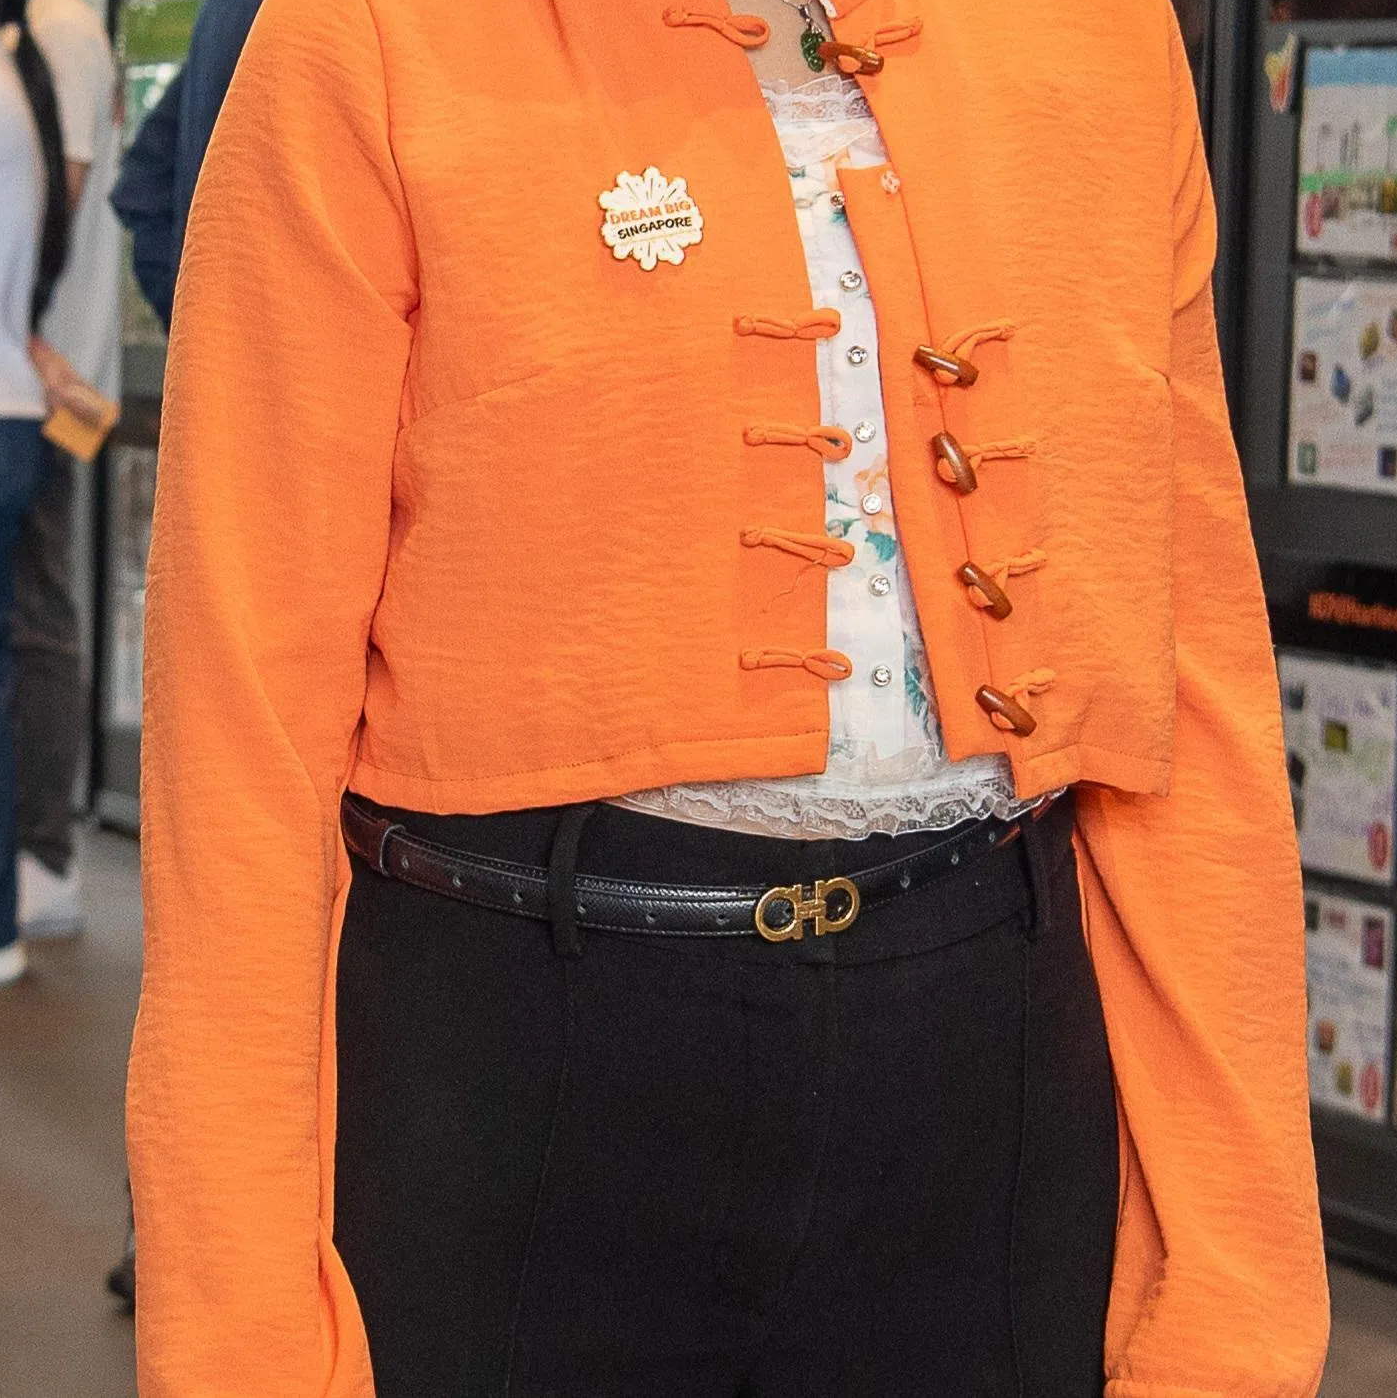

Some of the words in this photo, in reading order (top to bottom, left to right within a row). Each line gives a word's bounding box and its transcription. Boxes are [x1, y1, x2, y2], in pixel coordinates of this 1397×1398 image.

[610, 205, 662, 225] DREAM
[664, 200, 691, 214] BIG
[617, 216, 693, 239] SINGAPORE
